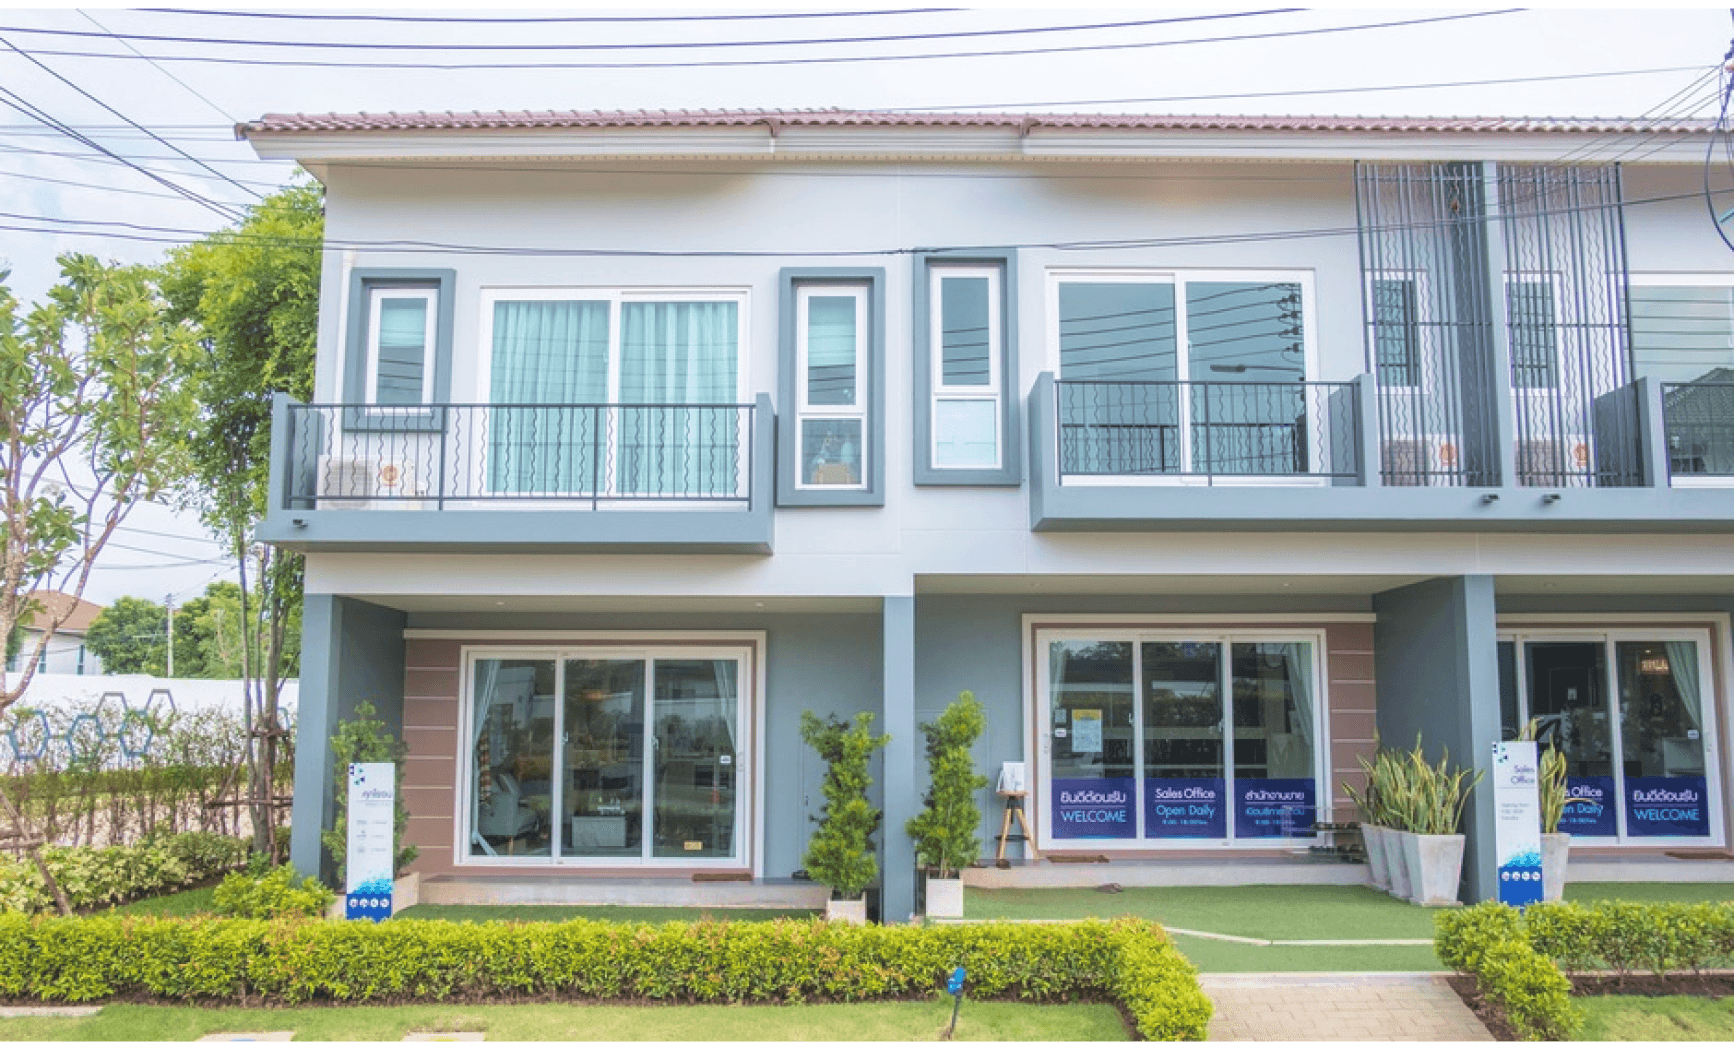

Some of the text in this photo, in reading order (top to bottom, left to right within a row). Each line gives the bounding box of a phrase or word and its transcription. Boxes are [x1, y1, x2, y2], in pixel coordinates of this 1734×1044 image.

[1514, 764, 1535, 773] Sales
[1510, 775, 1535, 784] Office
[1060, 790, 1127, 804] ยินดีต้อนรับ
[1155, 787, 1216, 799] Sales Office
[1244, 790, 1305, 801] สำนักงานขาย
[1571, 785, 1603, 797] Office
[1633, 789, 1698, 802] ยินดีต้อนรับ
[1060, 810, 1127, 822] WELCOME
[1155, 804, 1216, 819] Open Daily
[1577, 803, 1604, 817] Daily
[1634, 808, 1700, 821] WELCOME
